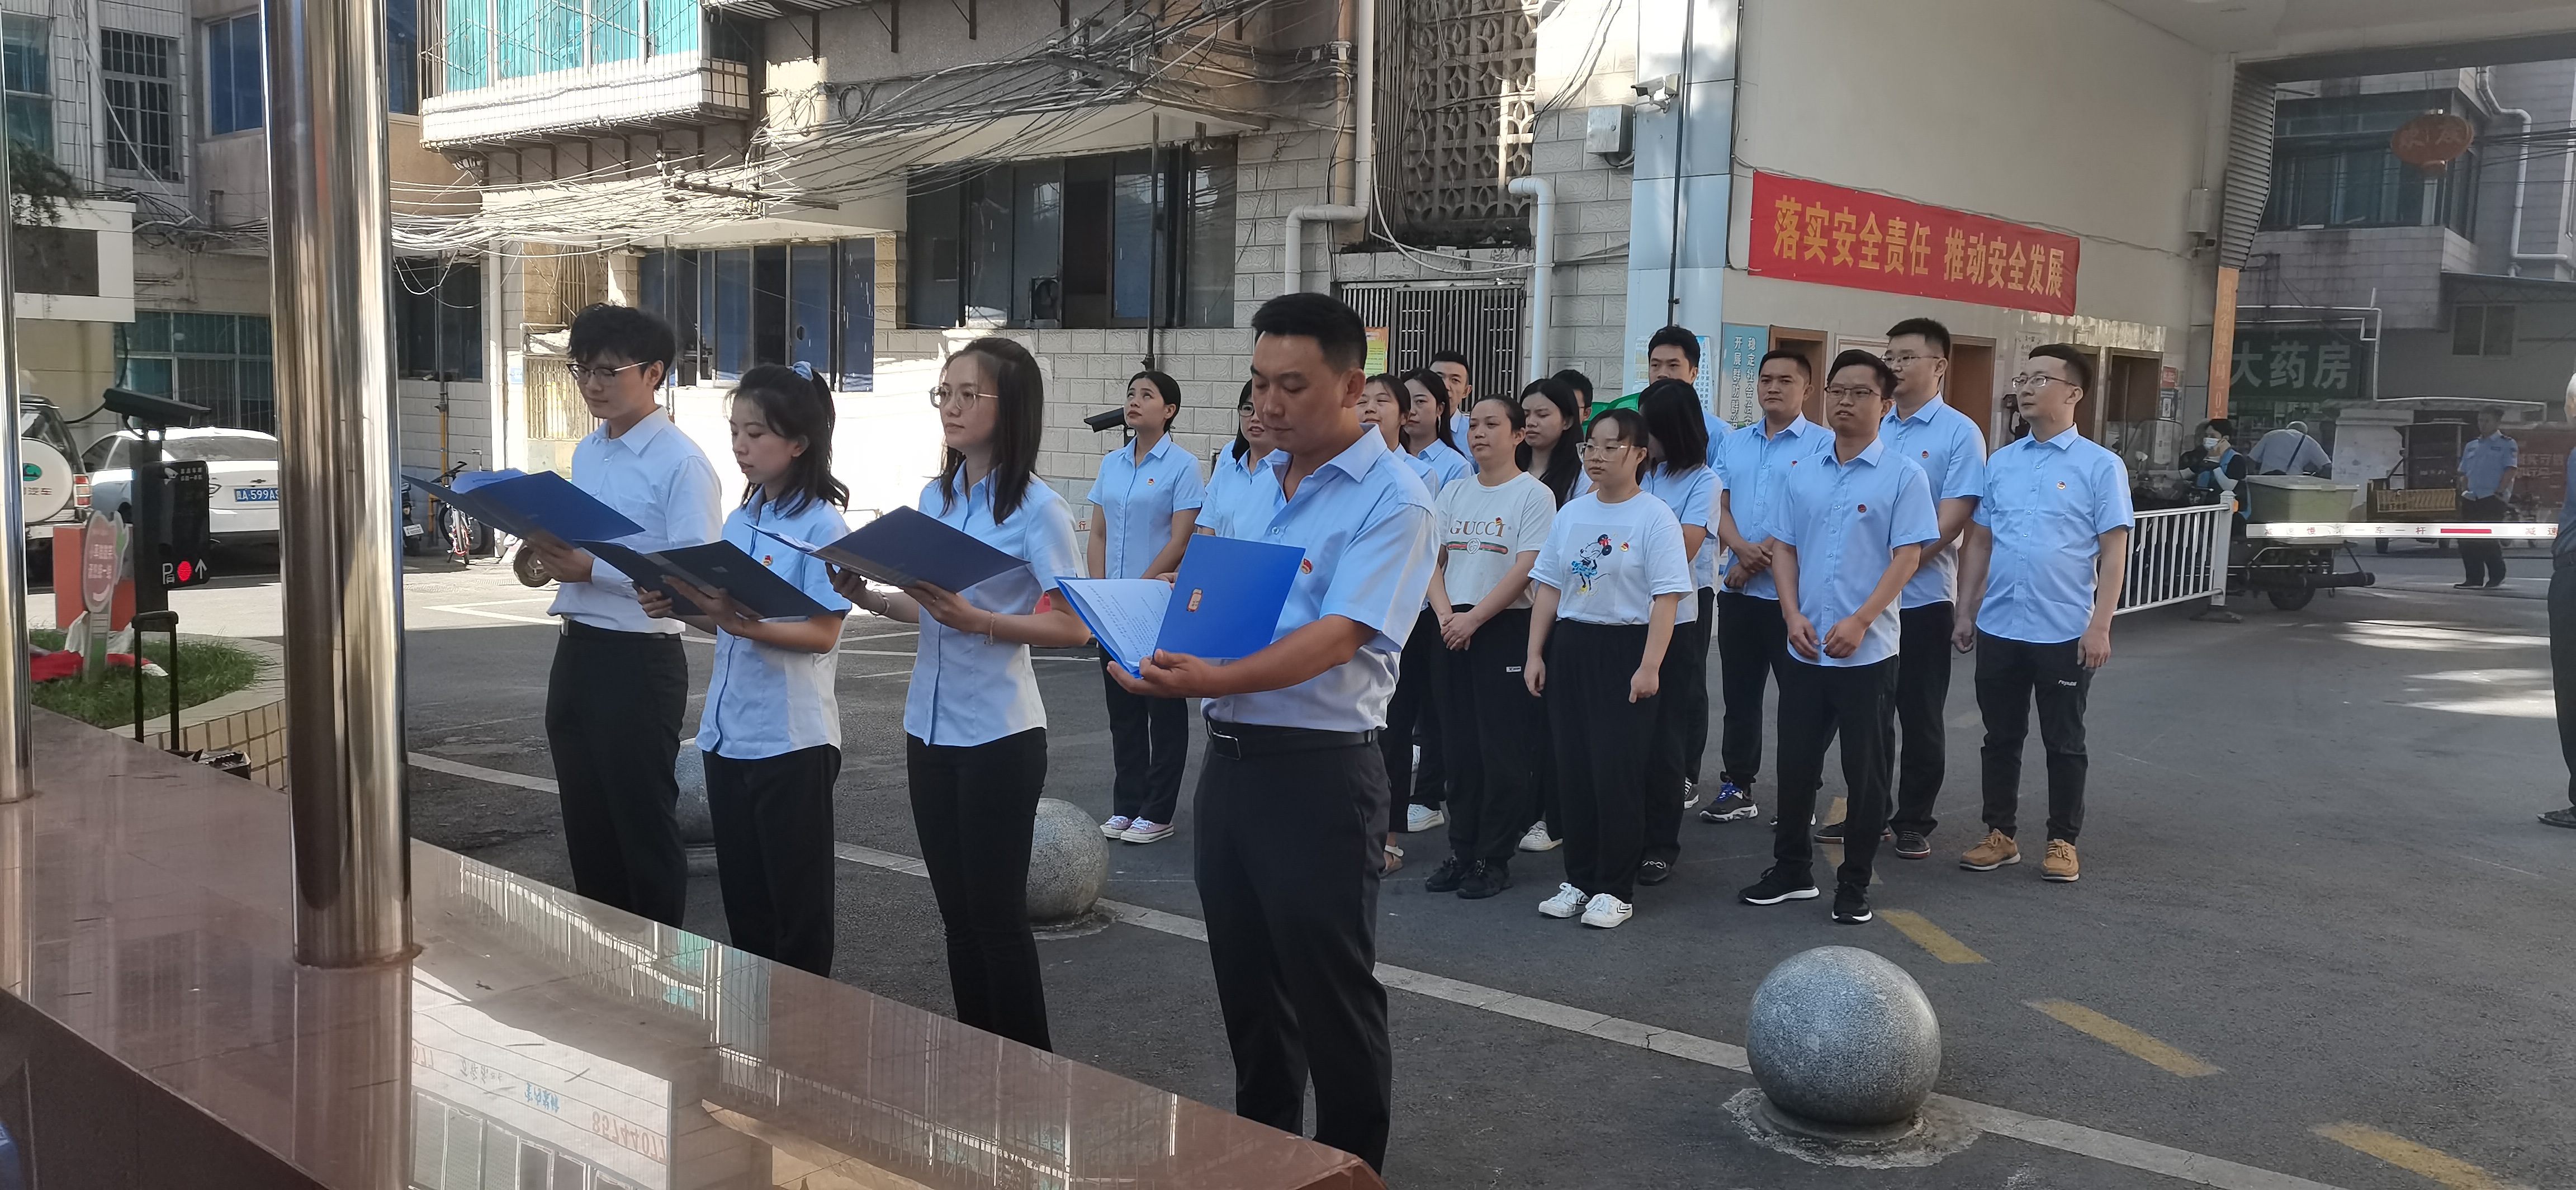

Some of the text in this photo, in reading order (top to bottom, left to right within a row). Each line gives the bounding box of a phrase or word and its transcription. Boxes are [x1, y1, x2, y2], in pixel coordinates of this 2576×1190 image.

[1773, 194, 2064, 298] 落实安全责任 推动安全发展
[1730, 337, 1742, 429] 开展群防群治
[2231, 341, 2351, 389] 大药房
[1450, 520, 1506, 537] GUCCI
